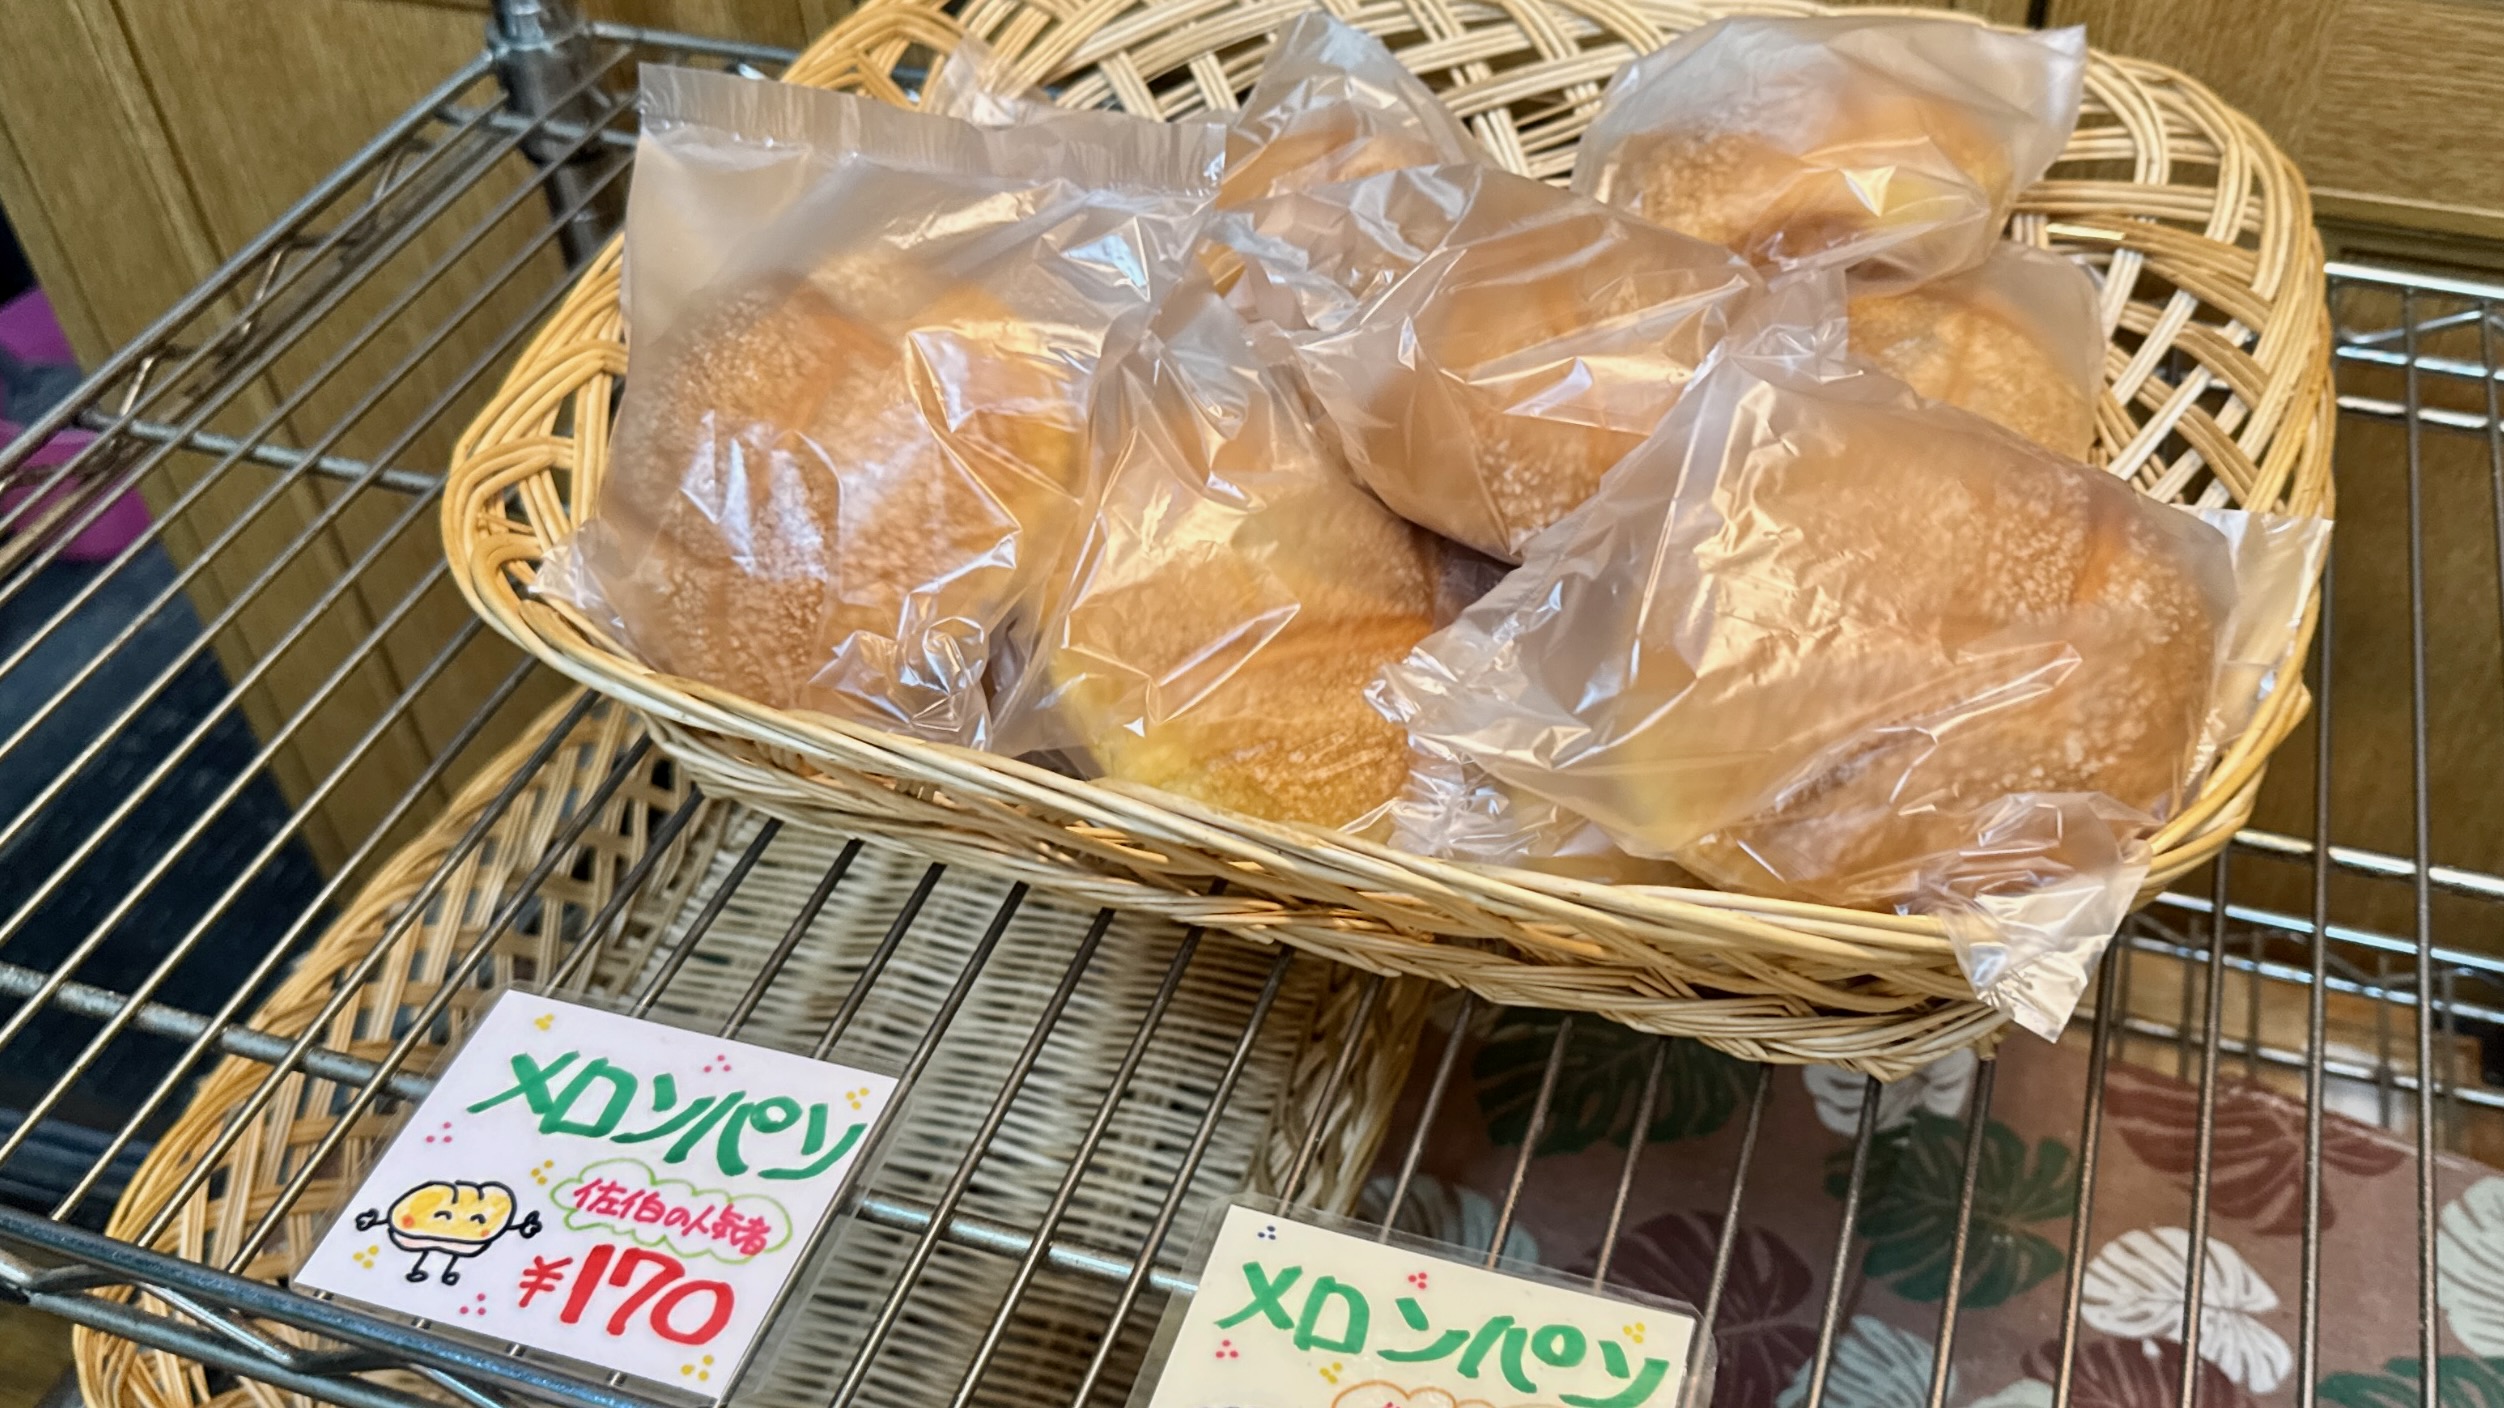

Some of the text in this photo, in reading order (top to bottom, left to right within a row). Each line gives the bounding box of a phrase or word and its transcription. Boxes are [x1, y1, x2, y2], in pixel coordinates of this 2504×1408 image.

[467, 1051, 867, 1179] メロンパン
[573, 1178, 771, 1256] 佐伯の人気者
[519, 1244, 734, 1345] ¥170
[1214, 1261, 1669, 1408] メロンパン
